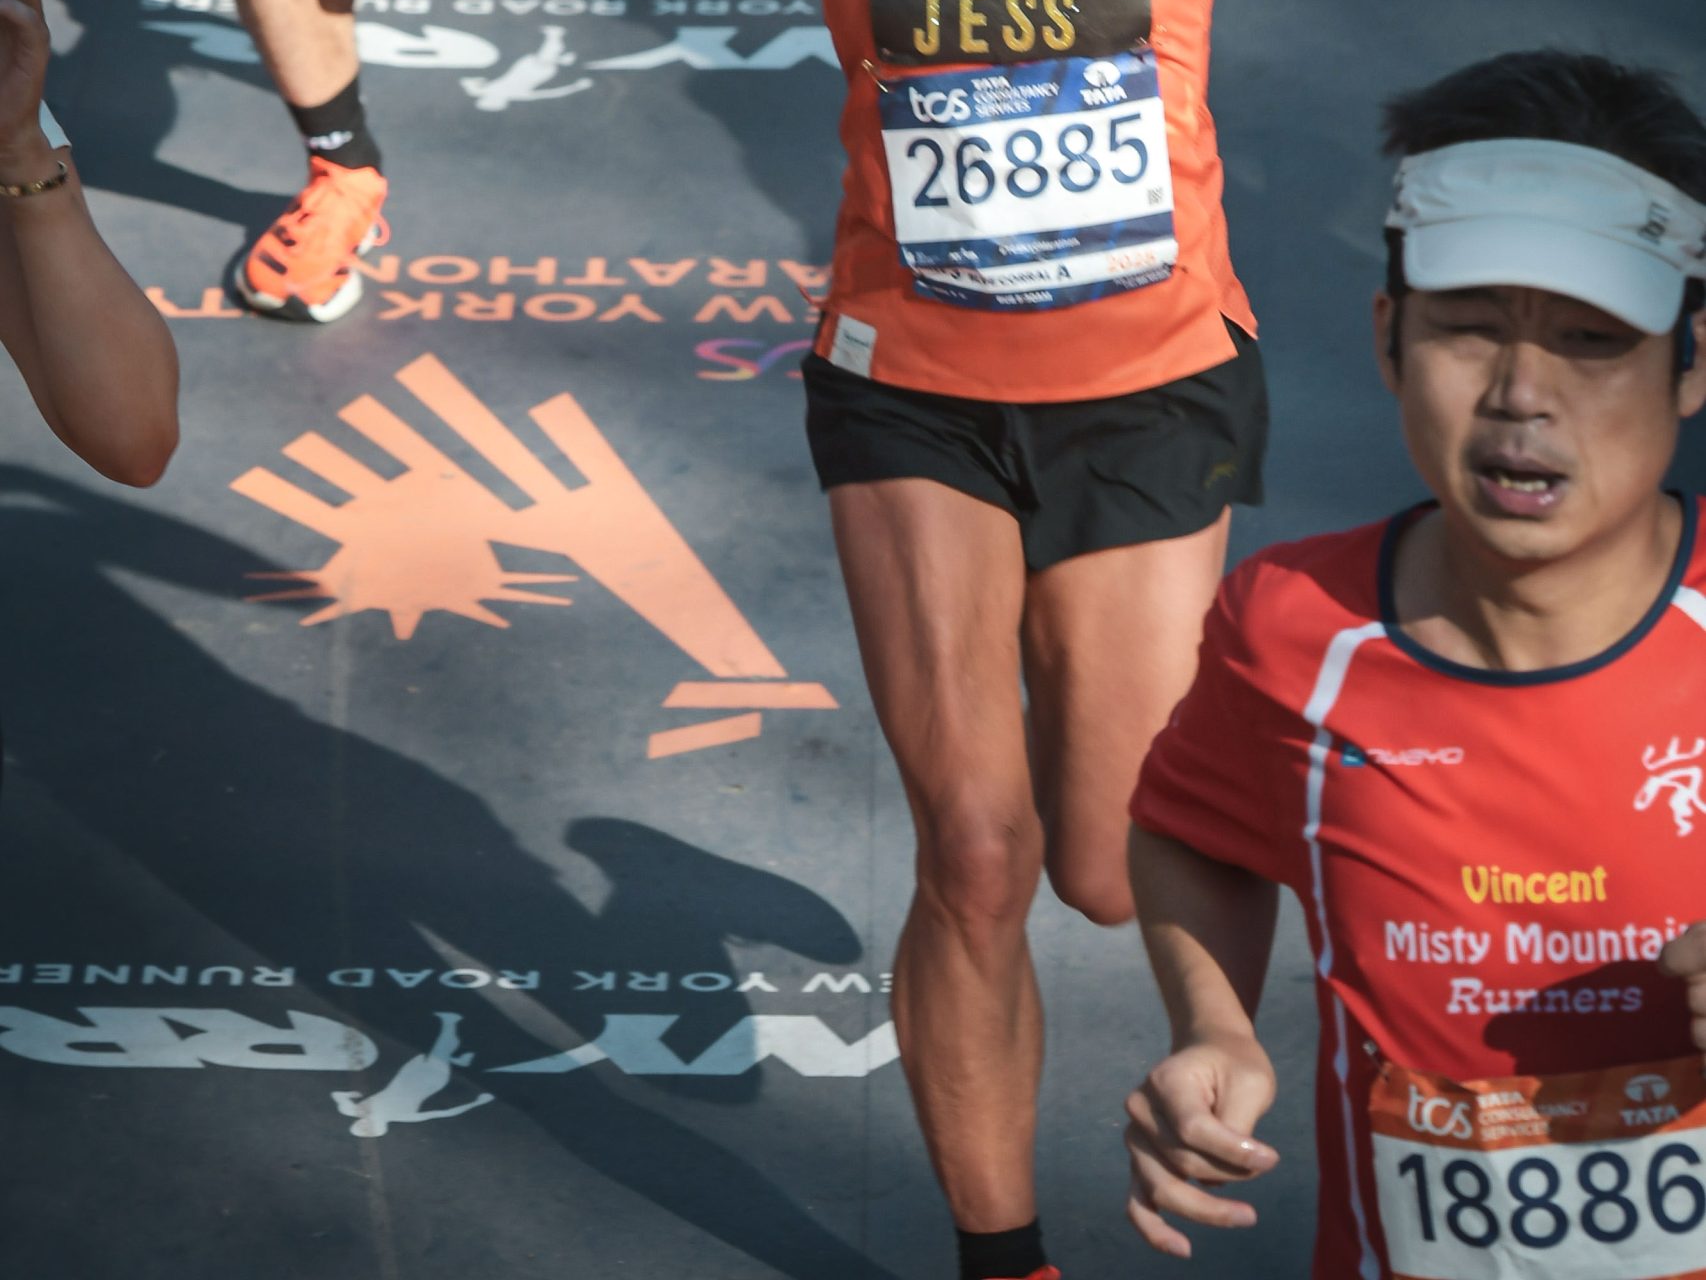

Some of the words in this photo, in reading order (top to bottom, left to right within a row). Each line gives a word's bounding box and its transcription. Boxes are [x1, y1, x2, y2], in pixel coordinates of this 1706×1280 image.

[908, 86, 972, 123] tcs
[1080, 84, 1128, 106] TATA
[906, 112, 1149, 209] 26885
[352, 255, 832, 288] ARATHON
[378, 290, 664, 323] YORK
[1461, 865, 1608, 904] Vincent
[1384, 921, 1491, 964] Misty
[1506, 916, 1690, 965] Mountai
[327, 968, 540, 989] ROAD
[573, 970, 779, 992] YORK
[1446, 978, 1643, 1014] Runners
[1407, 1084, 1473, 1139] tcs
[1476, 1091, 1526, 1108] TATA
[1619, 1104, 1680, 1127] TATA
[1398, 1142, 1706, 1249] 18886
